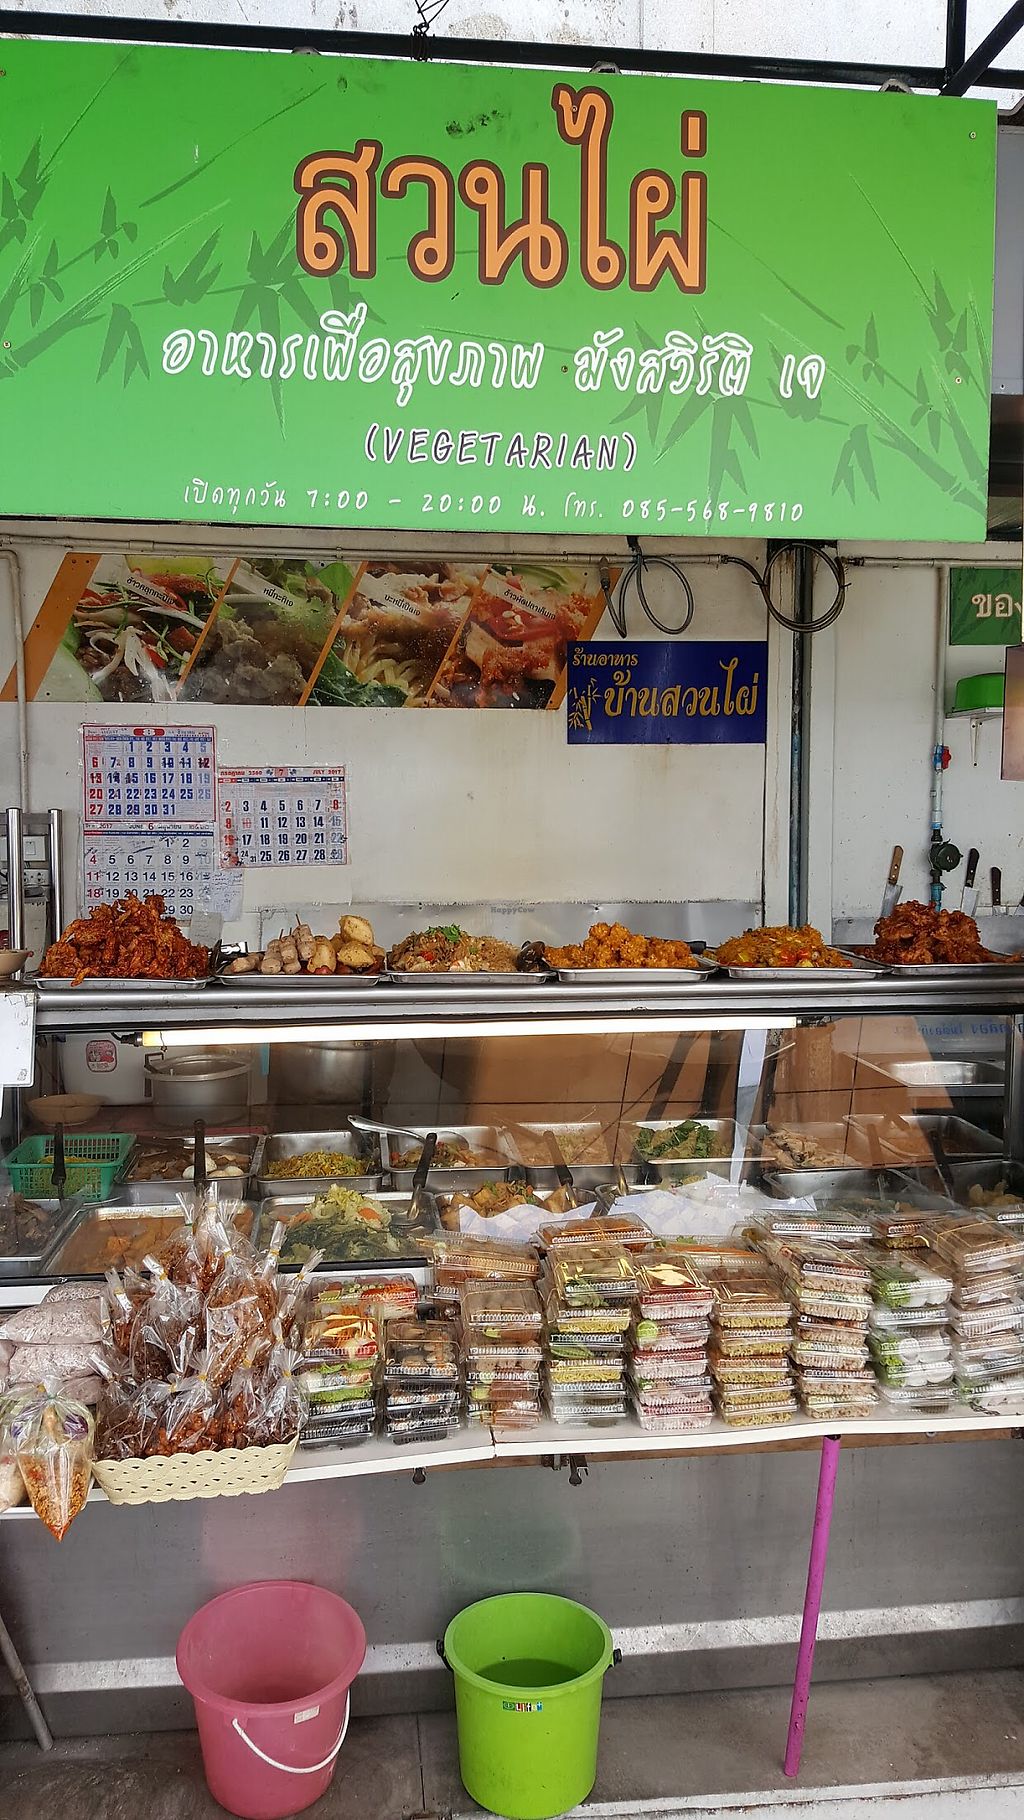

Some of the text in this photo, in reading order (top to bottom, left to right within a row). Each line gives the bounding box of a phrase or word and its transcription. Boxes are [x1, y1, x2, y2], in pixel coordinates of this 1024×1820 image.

[294, 83, 707, 294] สวนไผ่
[162, 302, 826, 407] อาหารเพื่อสุขภาพ มังสวิรัติ เจ
[365, 422, 638, 472] (VEGETARIAN)
[183, 477, 286, 515] เปิดทุกวัน
[306, 489, 369, 510] 7:00
[421, 494, 501, 514] 20:00
[521, 494, 545, 517] น.
[564, 491, 604, 518] โทร.
[622, 498, 803, 523] 085-568-9810
[572, 647, 639, 667] ร้านอาหาร
[603, 657, 759, 717] บ้านสวนไผ่
[129, 742, 207, 752] 1 2 3 4 5
[92, 757, 99, 768] 6
[110, 757, 117, 768] 7
[128, 757, 135, 768] 8
[146, 757, 153, 768] 9
[144, 773, 156, 784] 16
[162, 773, 174, 784] 17
[180, 773, 192, 784] 18
[198, 773, 210, 784] 19
[89, 789, 211, 799] 20 21 22 23 24 25 26
[90, 804, 175, 815] 27 28 29 30 31
[225, 801, 231, 812] 2
[243, 801, 249, 812] 3
[260, 801, 267, 812] 4
[279, 800, 285, 811] 5
[297, 800, 303, 810] 6
[315, 800, 321, 810] 7
[148, 822, 155, 830] 6
[226, 818, 232, 829] 9
[260, 817, 269, 828] 11
[278, 817, 288, 828] 12
[296, 817, 306, 828] 13
[313, 816, 324, 827] 14
[165, 839, 170, 848] 1
[182, 839, 190, 848] 2
[242, 835, 252, 845] 17
[260, 834, 270, 845] 18
[278, 834, 288, 844] 19
[296, 833, 307, 844] 20
[314, 833, 324, 843] 21
[90, 855, 97, 864] 4
[108, 855, 116, 864] 5
[127, 855, 135, 864] 6
[145, 855, 153, 864] 7
[164, 855, 172, 864] 8
[182, 855, 190, 864] 9
[260, 850, 272, 862] 25
[278, 850, 290, 861] 26
[296, 850, 308, 861] 27
[313, 849, 325, 860] 28
[87, 872, 193, 881] 11 12 13 14 15 16
[87, 888, 100, 898] 18
[106, 888, 119, 898] 19
[161, 888, 175, 898] 22
[179, 888, 193, 898] 23
[179, 905, 193, 914] 30
